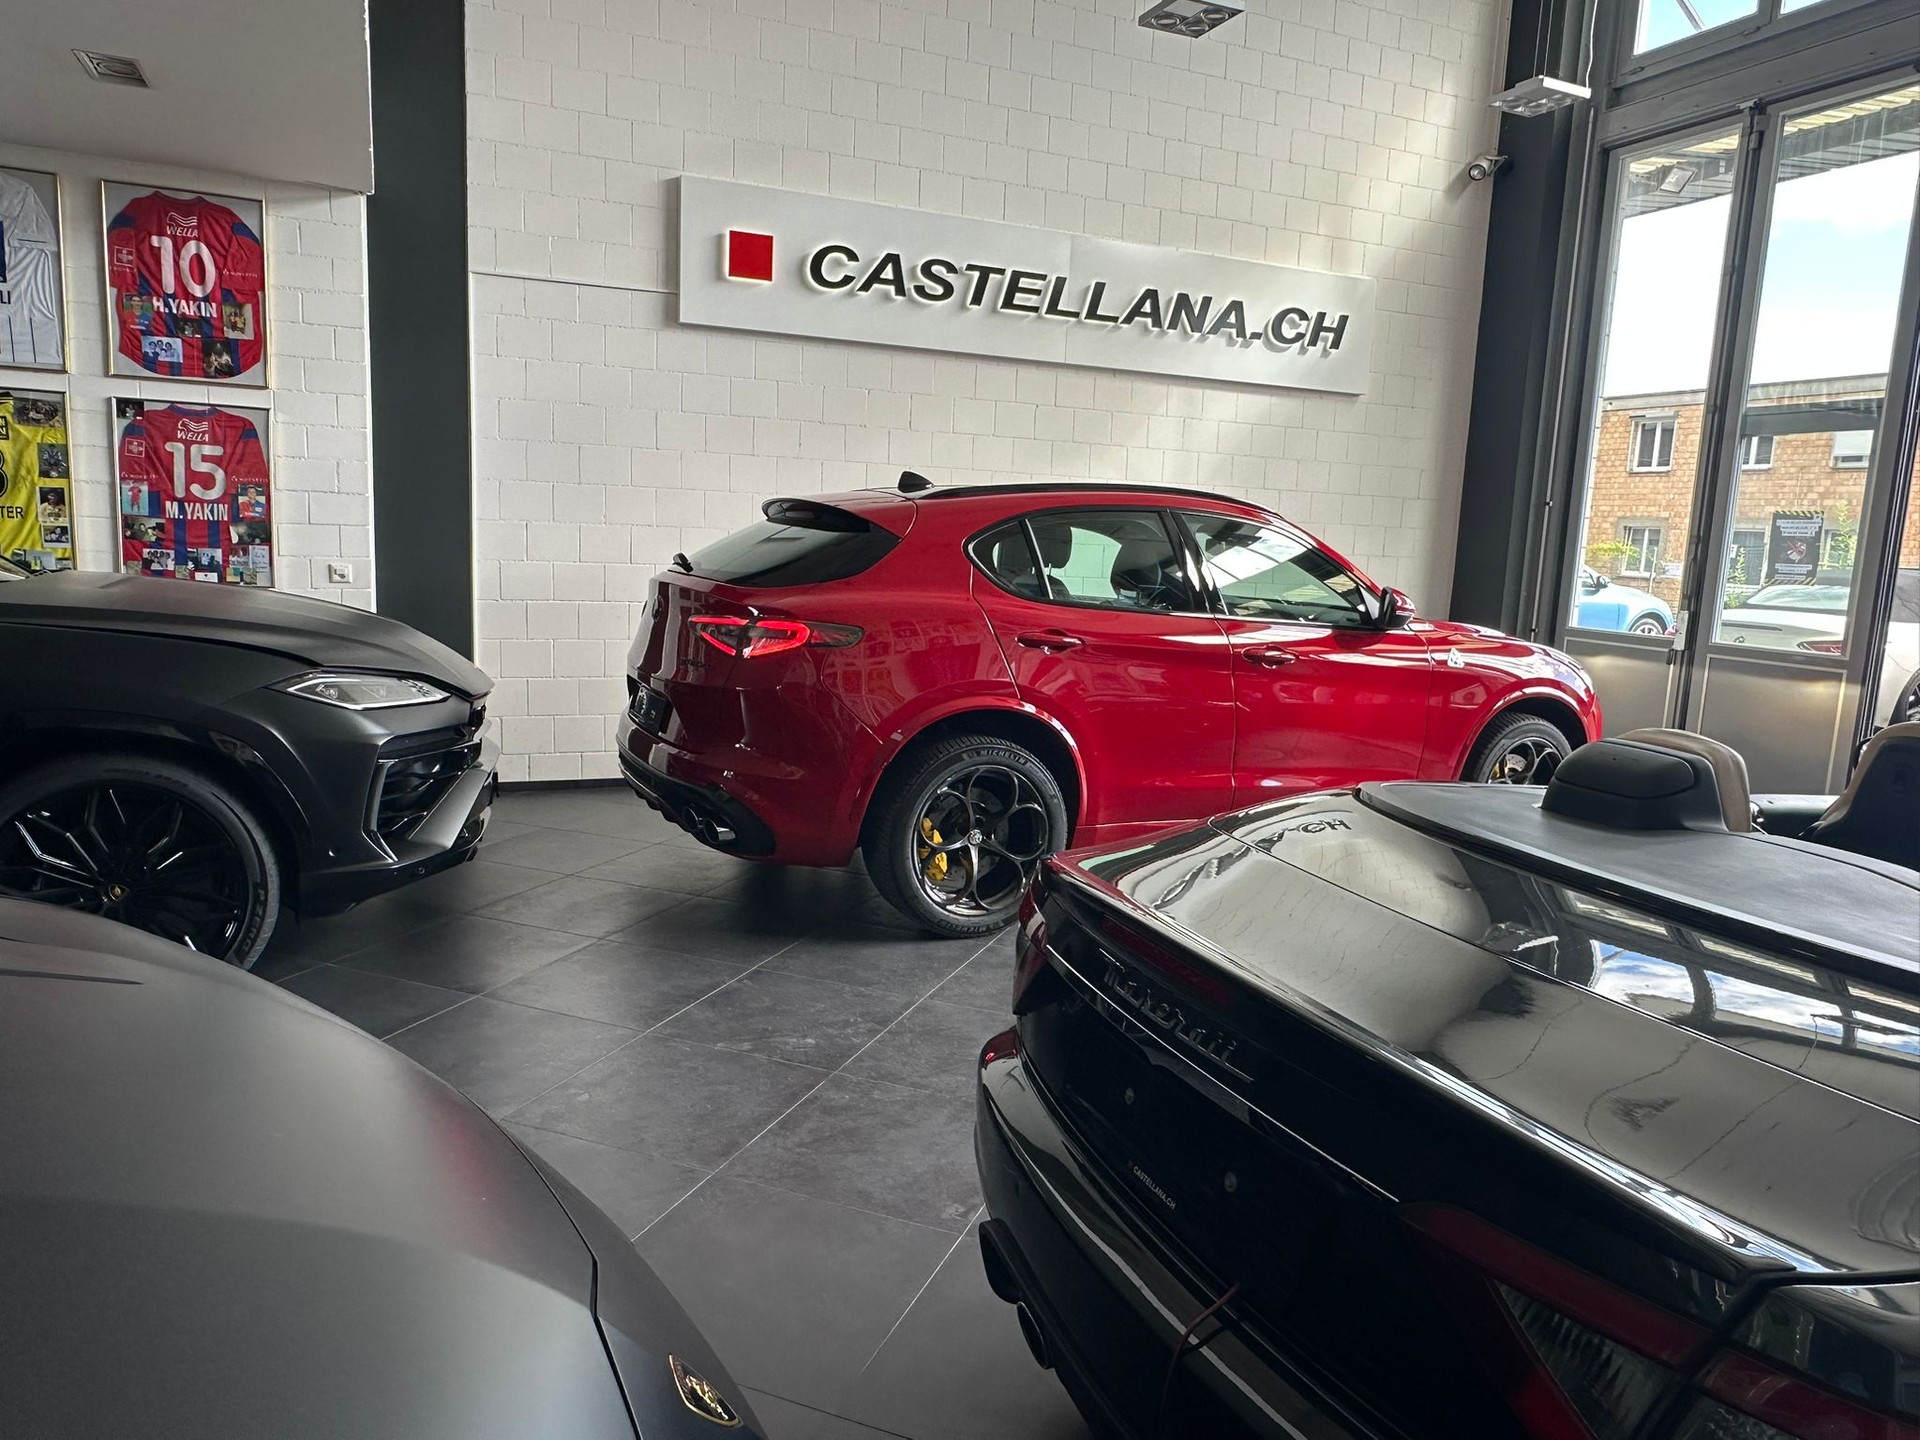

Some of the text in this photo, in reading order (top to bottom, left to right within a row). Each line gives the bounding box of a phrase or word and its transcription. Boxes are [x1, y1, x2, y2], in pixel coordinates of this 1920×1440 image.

[166, 226, 199, 238] WELLA
[150, 235, 216, 298] 10
[809, 244, 1349, 350] CASTELLANA.CH
[176, 430, 209, 442] WELLA
[164, 441, 226, 500] 15
[1133, 1166, 1176, 1210] CASTELLANA.CH
